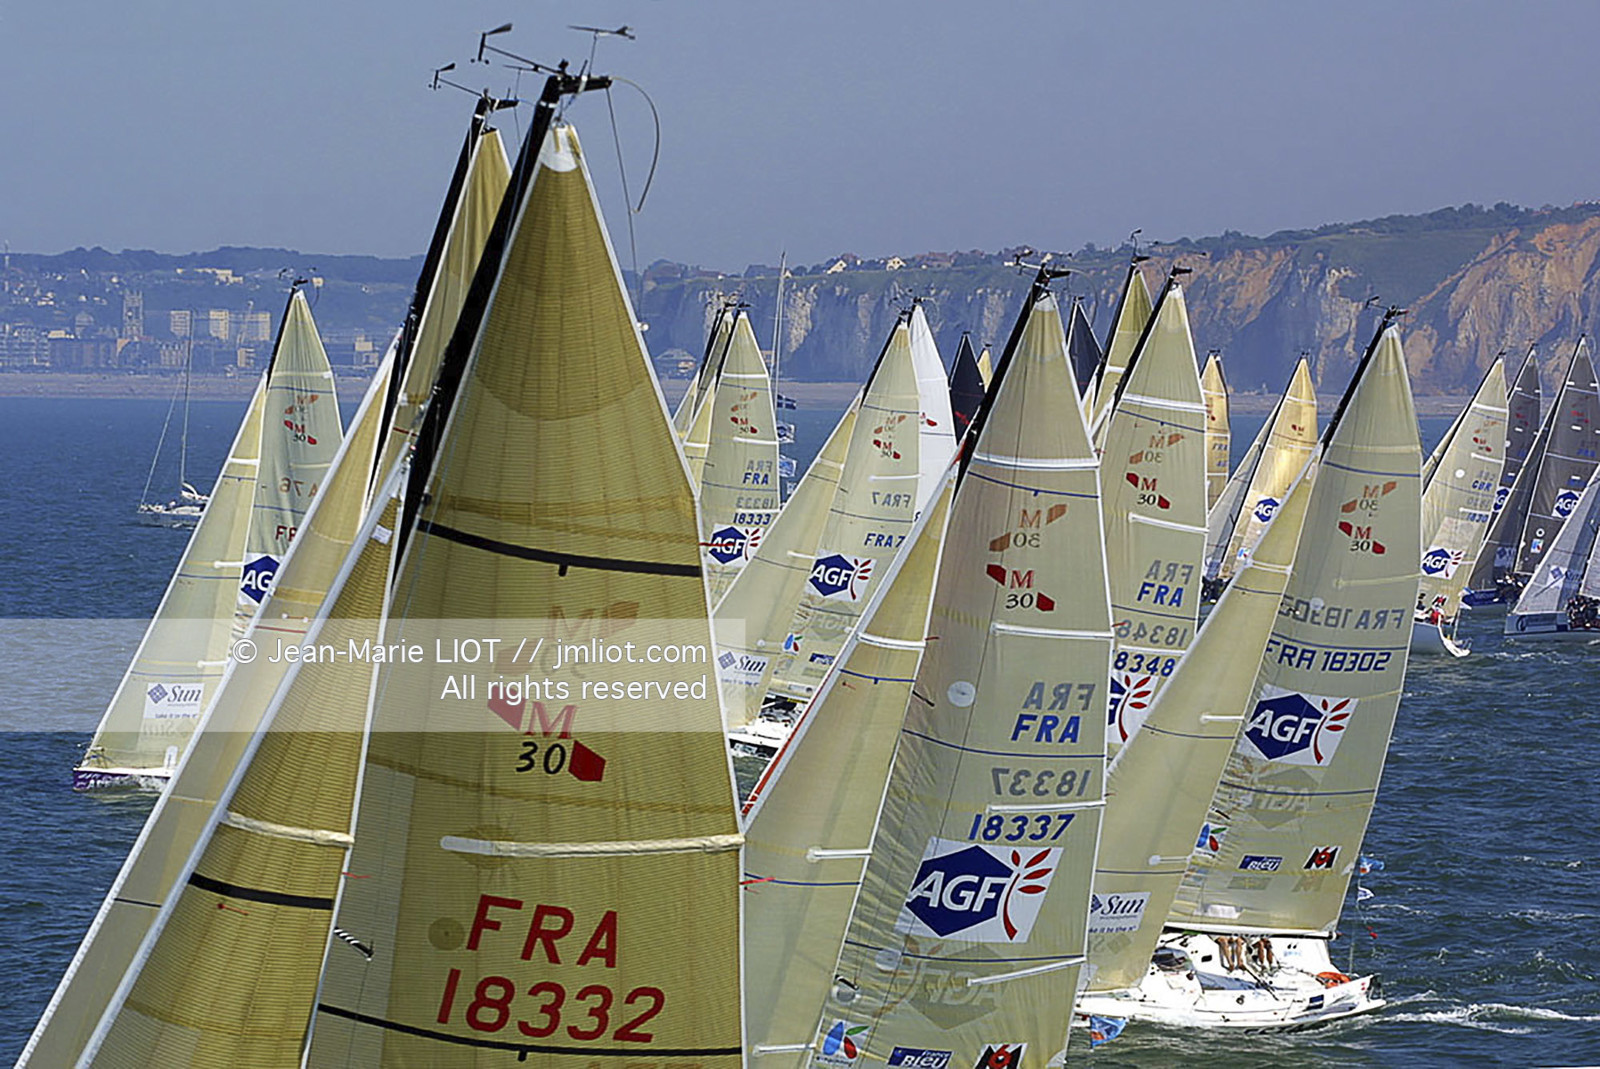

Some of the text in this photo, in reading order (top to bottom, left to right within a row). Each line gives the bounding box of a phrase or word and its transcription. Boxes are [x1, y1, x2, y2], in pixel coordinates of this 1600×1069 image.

[742, 472, 769, 485] FRA
[1141, 477, 1158, 491] M
[1136, 493, 1156, 506] 30
[733, 512, 771, 525] 18333
[1354, 526, 1372, 540] M
[708, 537, 745, 555] AGF
[1350, 540, 1371, 552] 30
[1423, 554, 1449, 570] AGF
[811, 564, 854, 588] AGF
[1010, 570, 1035, 589] M
[1005, 592, 1034, 609] 30
[1137, 581, 1185, 607] FRA
[735, 655, 766, 673] Sun
[1321, 651, 1392, 672] 18302
[167, 685, 201, 702] Sun
[523, 700, 580, 740] M
[1010, 713, 1081, 744] FRA
[1247, 709, 1319, 744] AGF
[515, 740, 568, 775] 30
[968, 813, 1076, 842] 18337
[908, 869, 1010, 913] AGF
[1100, 895, 1145, 915] Sun
[466, 893, 618, 969] FRA
[437, 968, 666, 1044] 18332
